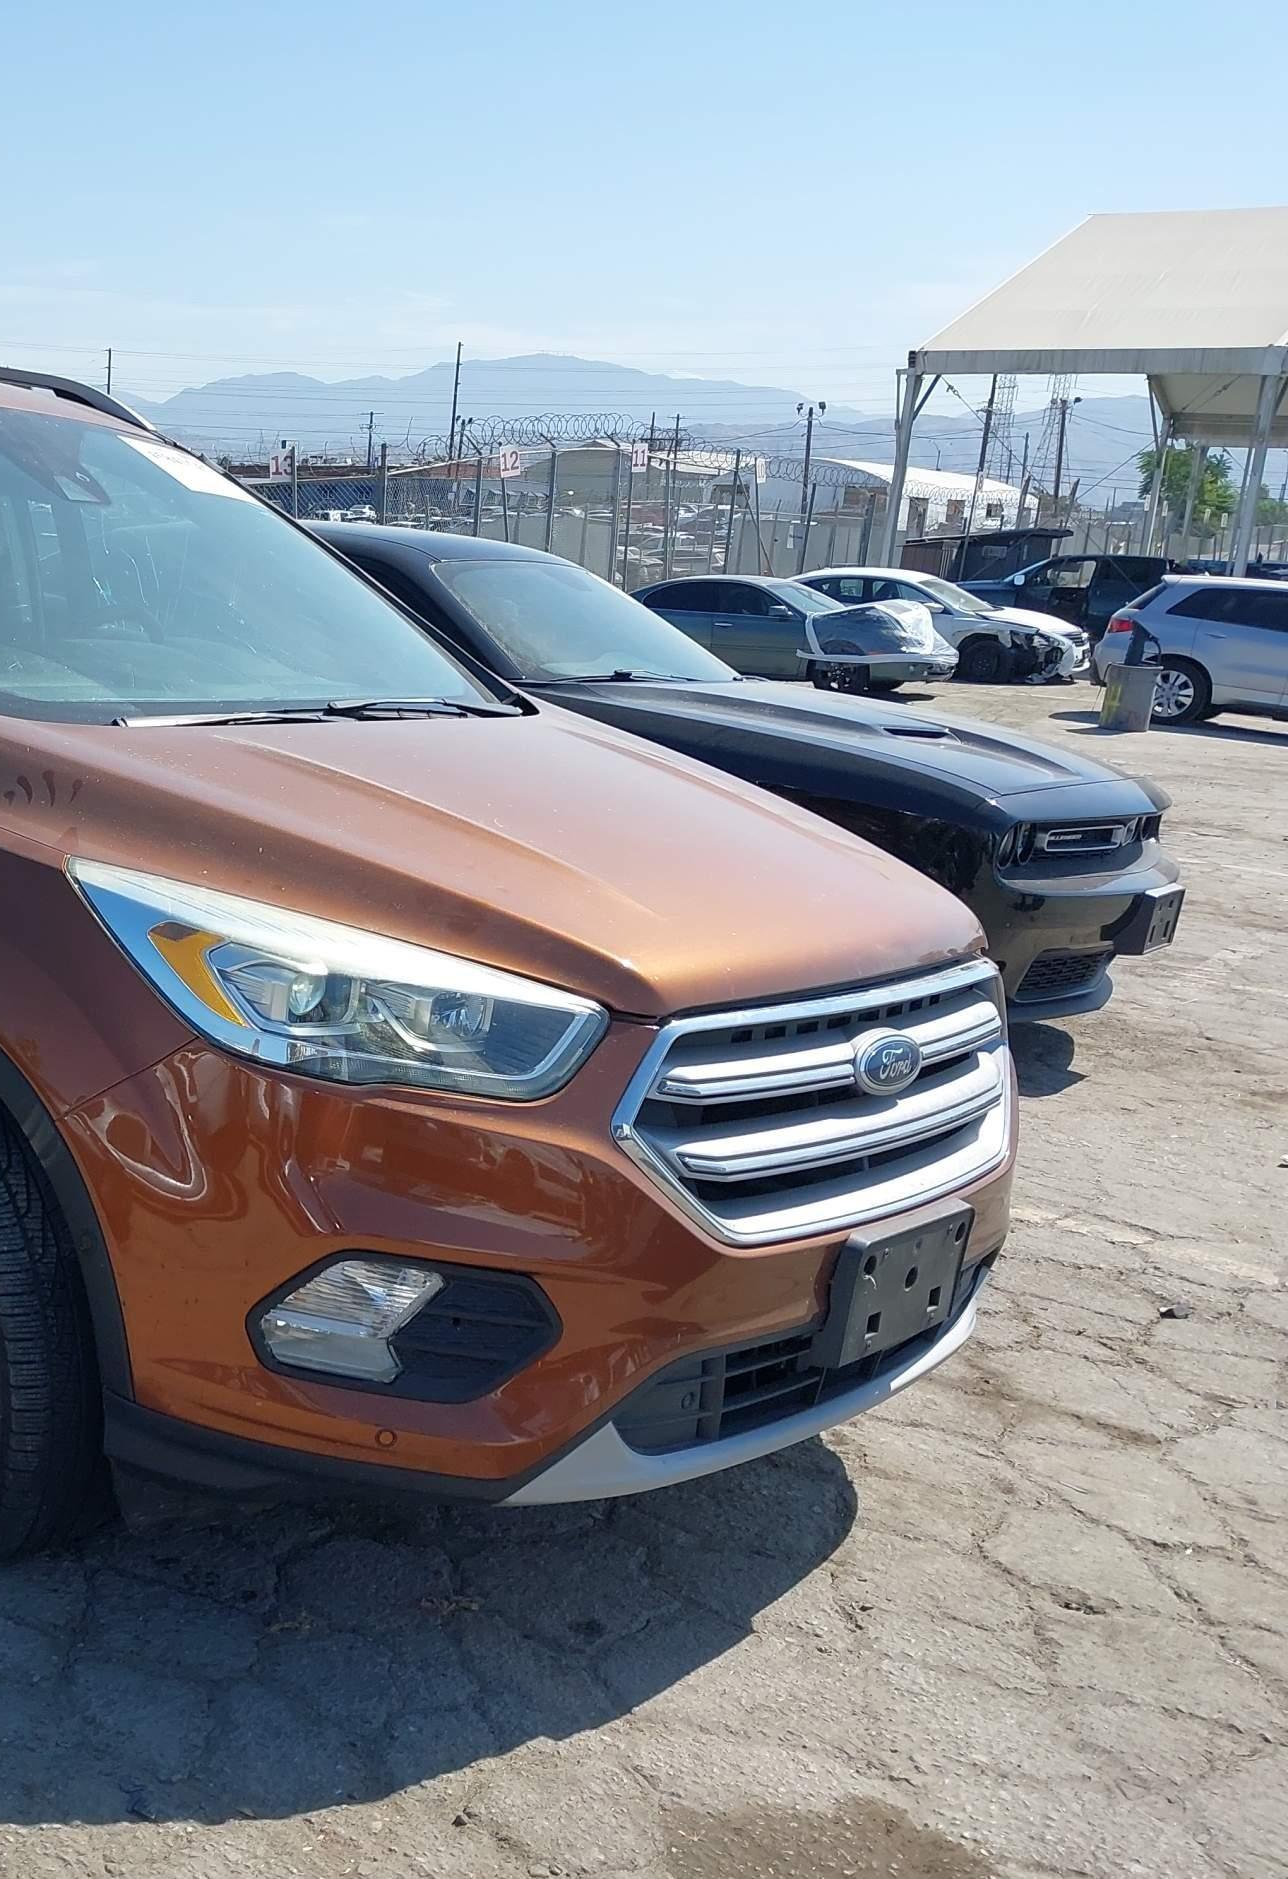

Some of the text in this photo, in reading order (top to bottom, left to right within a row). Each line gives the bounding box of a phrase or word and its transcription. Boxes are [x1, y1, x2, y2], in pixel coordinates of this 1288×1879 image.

[272, 455, 293, 476] 13
[501, 451, 520, 472] 12
[632, 450, 646, 467] 11
[879, 1047, 912, 1080] Ford
